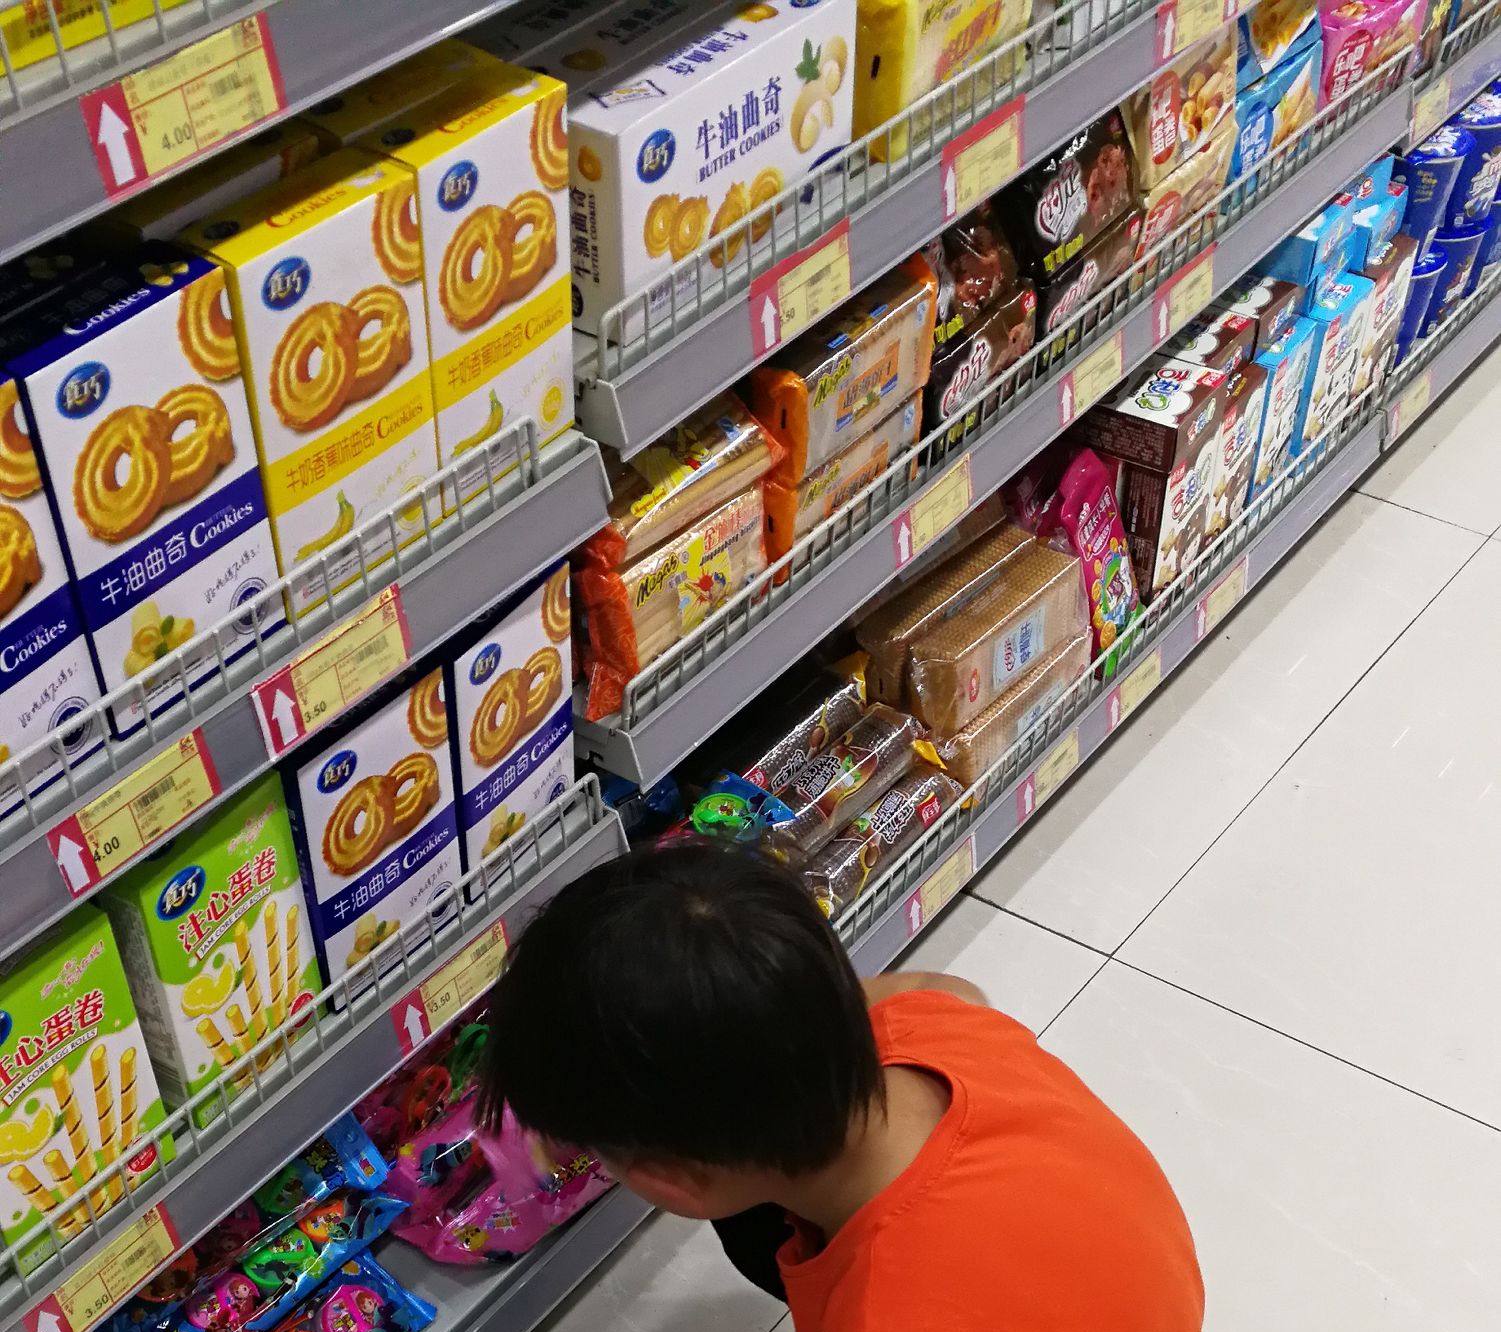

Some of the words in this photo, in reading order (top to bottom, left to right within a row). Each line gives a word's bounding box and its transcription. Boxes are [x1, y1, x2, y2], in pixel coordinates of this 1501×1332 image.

[161, 122, 193, 150] 4.00
[696, 75, 782, 160] 牛油曲奇
[699, 148, 736, 182] BUTTER
[739, 117, 780, 156] COOKIES
[265, 188, 347, 229] Cookies
[64, 287, 151, 335] Cookies
[376, 400, 424, 440] Cookies
[100, 531, 187, 606] 牛油曲奇
[189, 501, 254, 549] Cookies
[636, 552, 679, 609] Megas
[0, 617, 68, 674] Cookies
[303, 700, 327, 723] 3.50
[475, 751, 530, 810] 牛油曲奇
[530, 721, 568, 762] Cookies
[91, 835, 121, 863] 4.00
[333, 858, 401, 920] 牛油曲奇
[402, 827, 449, 870] Cookies
[162, 868, 201, 914] 真巧
[178, 846, 276, 952] 注心蛋卷
[200, 936, 215, 954] JAM
[216, 917, 234, 938] CORE
[235, 904, 249, 919] EGG
[249, 887, 270, 905] ROLLS
[8, 1082, 26, 1100] JAM
[27, 1061, 50, 1083] CORE
[50, 1047, 69, 1064] EGG
[70, 1029, 97, 1049] ROLLS
[84, 1294, 110, 1319] 3.50
